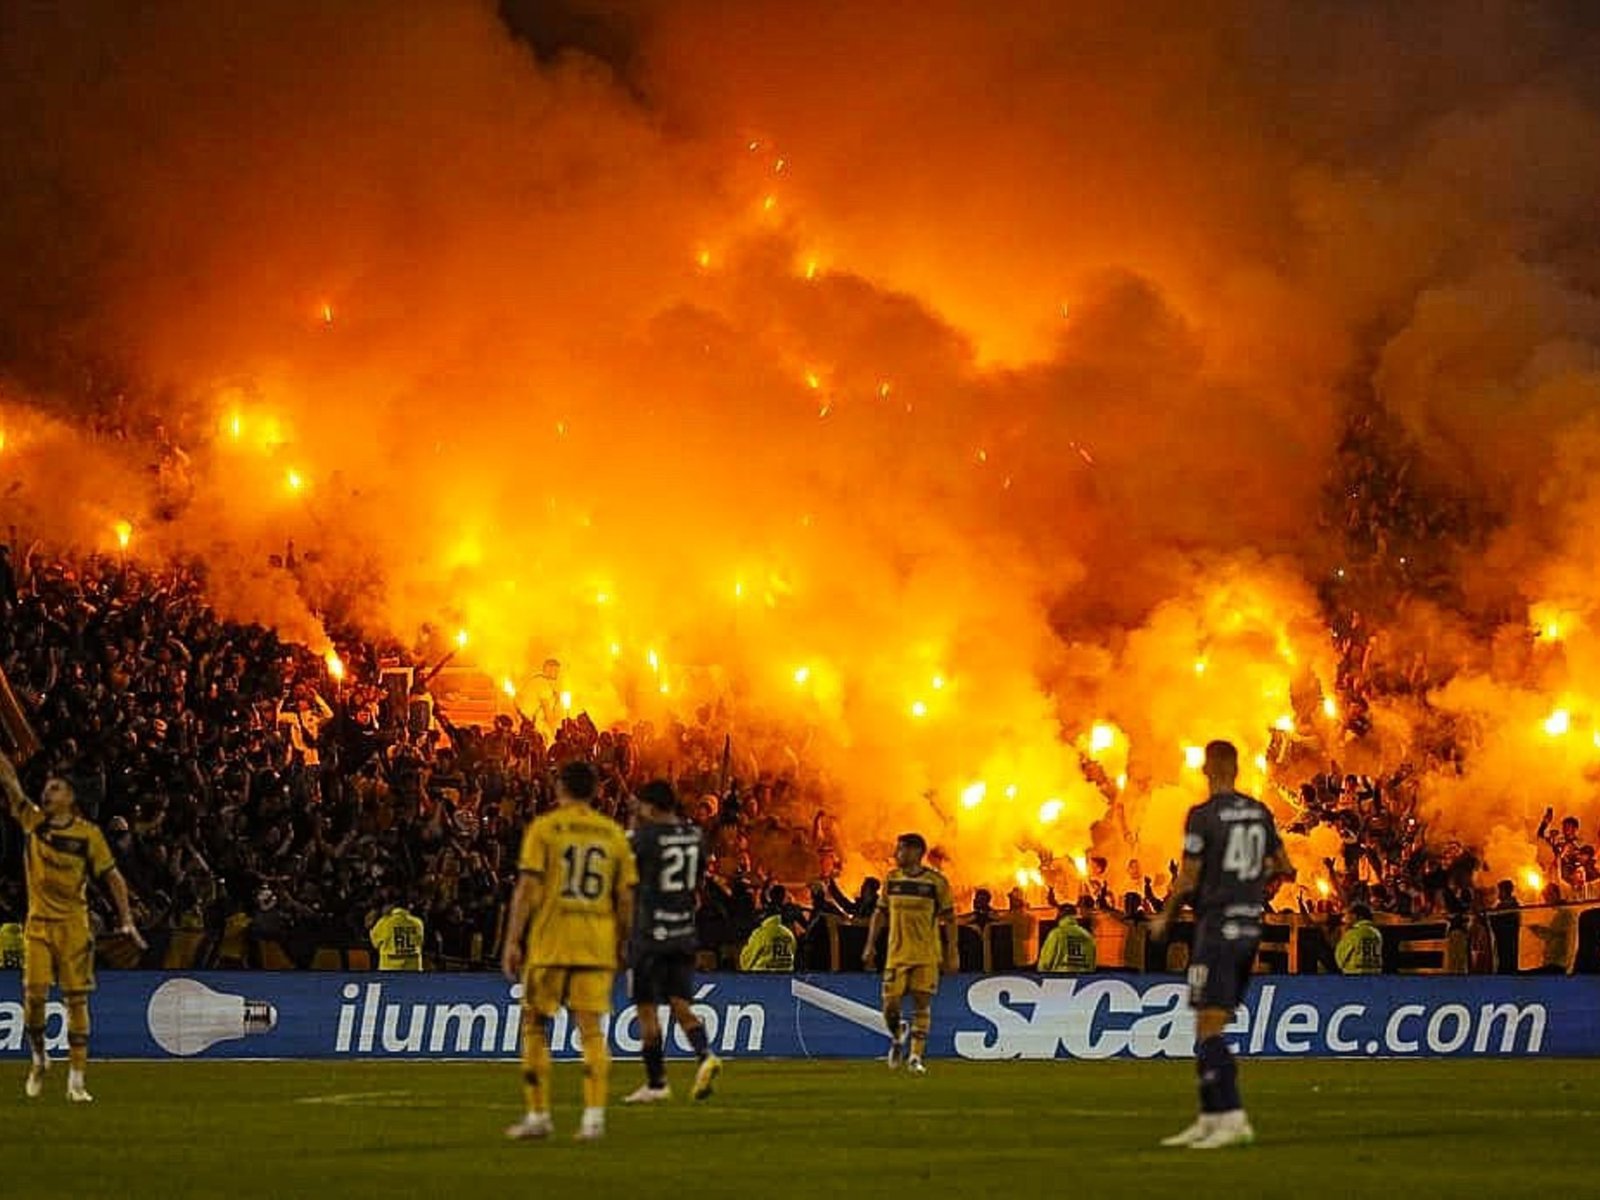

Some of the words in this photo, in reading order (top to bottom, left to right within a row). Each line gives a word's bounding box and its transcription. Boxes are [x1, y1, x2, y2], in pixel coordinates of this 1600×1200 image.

[560, 844, 607, 900] 16
[660, 845, 699, 891] 21
[1222, 823, 1267, 881] 40
